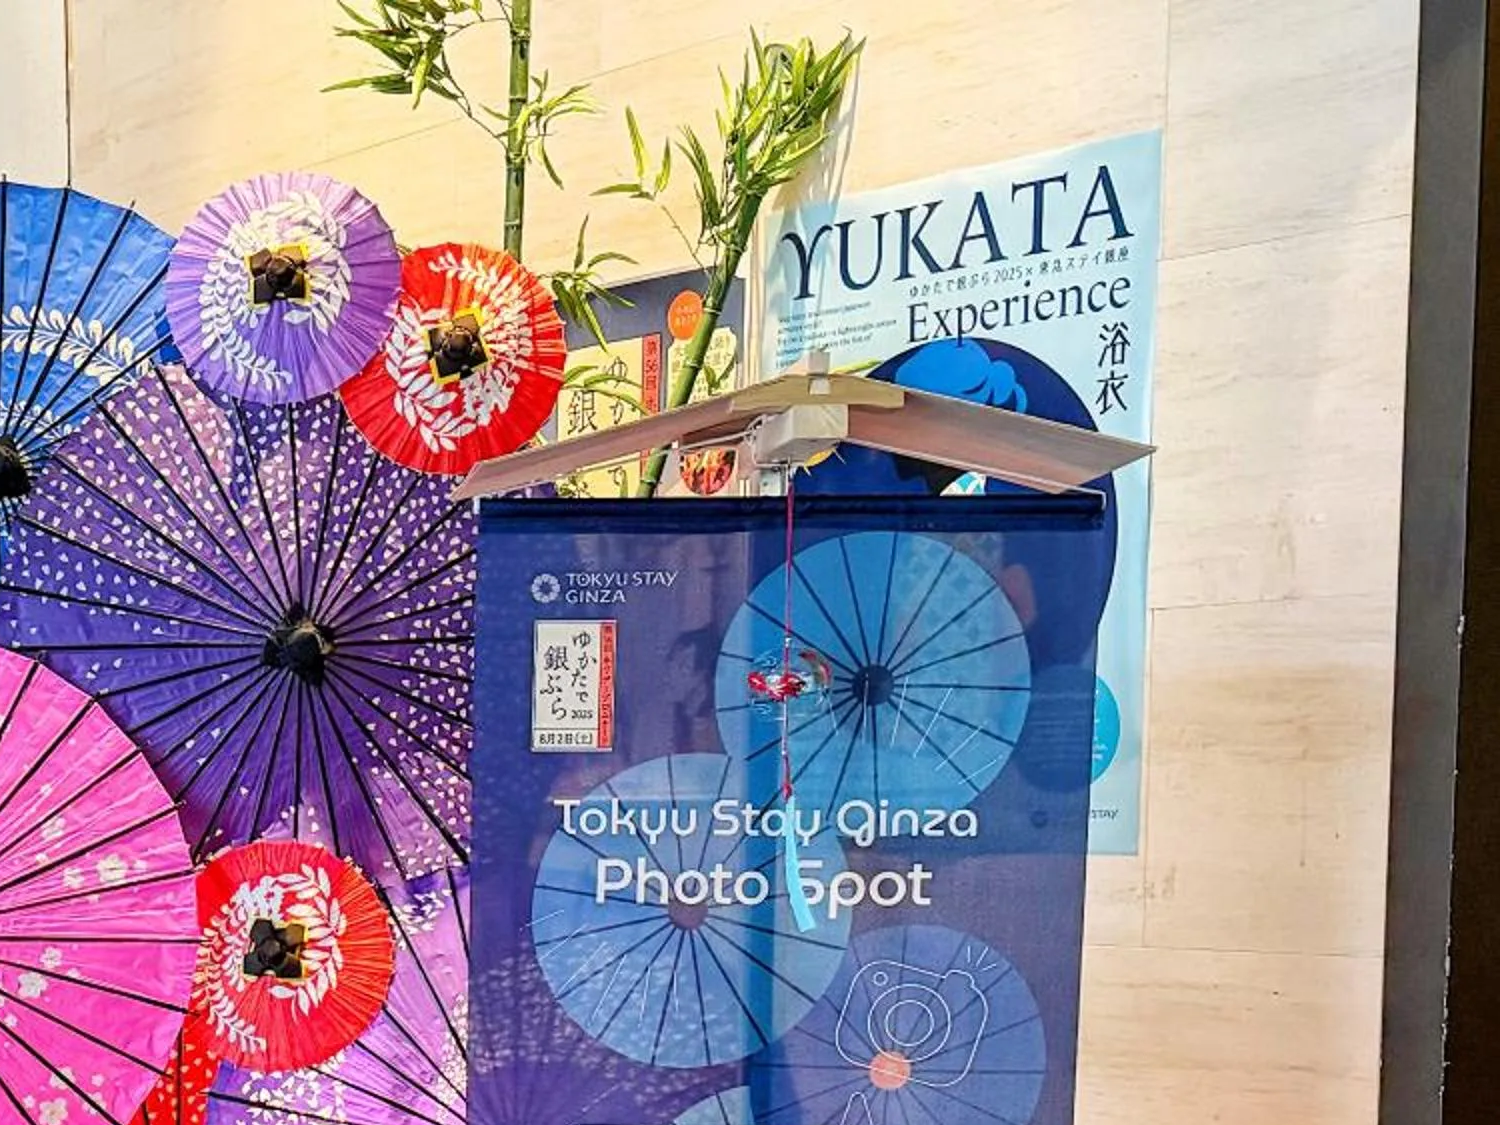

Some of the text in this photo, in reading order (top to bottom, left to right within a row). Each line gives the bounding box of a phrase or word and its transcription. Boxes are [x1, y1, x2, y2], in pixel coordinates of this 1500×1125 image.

[782, 165, 1134, 300] YUKATA
[907, 276, 1131, 347] Experience
[1096, 322, 1130, 414] 浴衣
[565, 570, 679, 588] TOKYU STAY
[565, 589, 627, 603] GINZA
[540, 646, 570, 721] 銀ぶら
[554, 799, 978, 848] Tokyu Stay Ginza
[596, 857, 932, 920] Photo Spot
